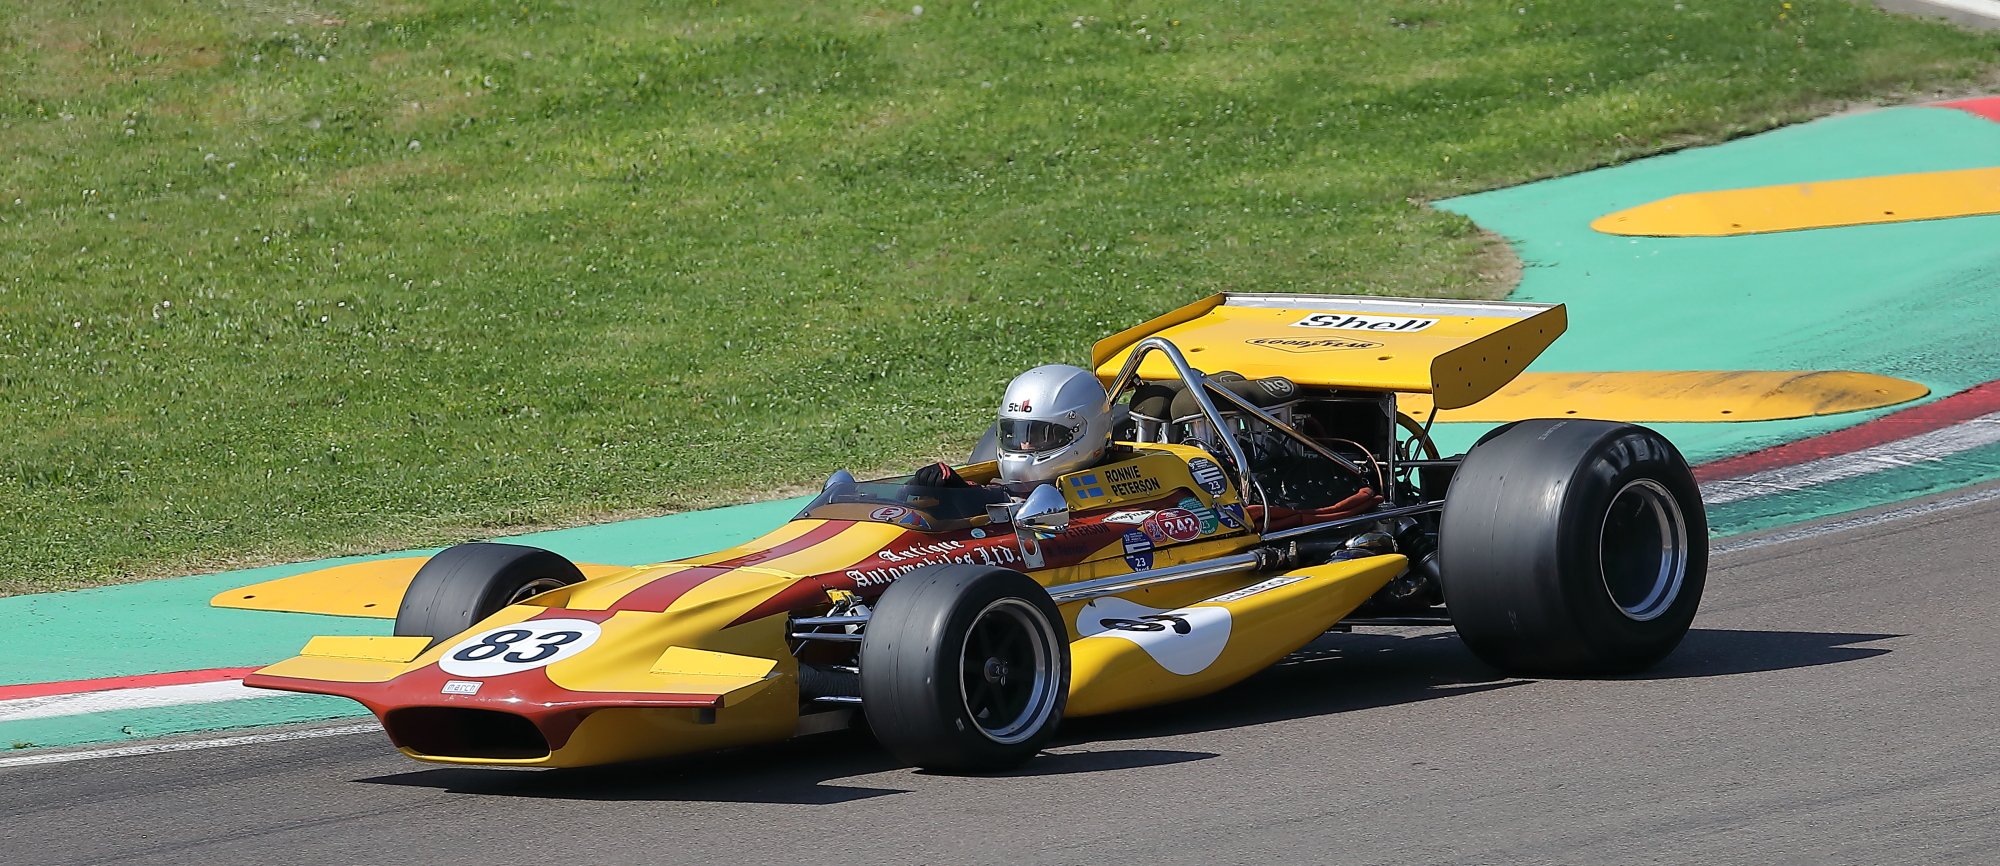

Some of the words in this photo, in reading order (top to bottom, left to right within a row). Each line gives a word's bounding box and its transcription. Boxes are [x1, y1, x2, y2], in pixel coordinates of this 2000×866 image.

[1300, 315, 1431, 331] Shell
[1007, 399, 1033, 413] Stilo
[1595, 435, 1669, 486] AVON
[1105, 466, 1141, 483] RONNIE
[1111, 477, 1161, 497] PETERSON
[1208, 480, 1220, 490] 23
[878, 539, 966, 563] Antique
[973, 544, 1022, 567] Ltd.
[1135, 557, 1147, 567] 23
[453, 629, 583, 663] 83
[446, 684, 476, 692] march
